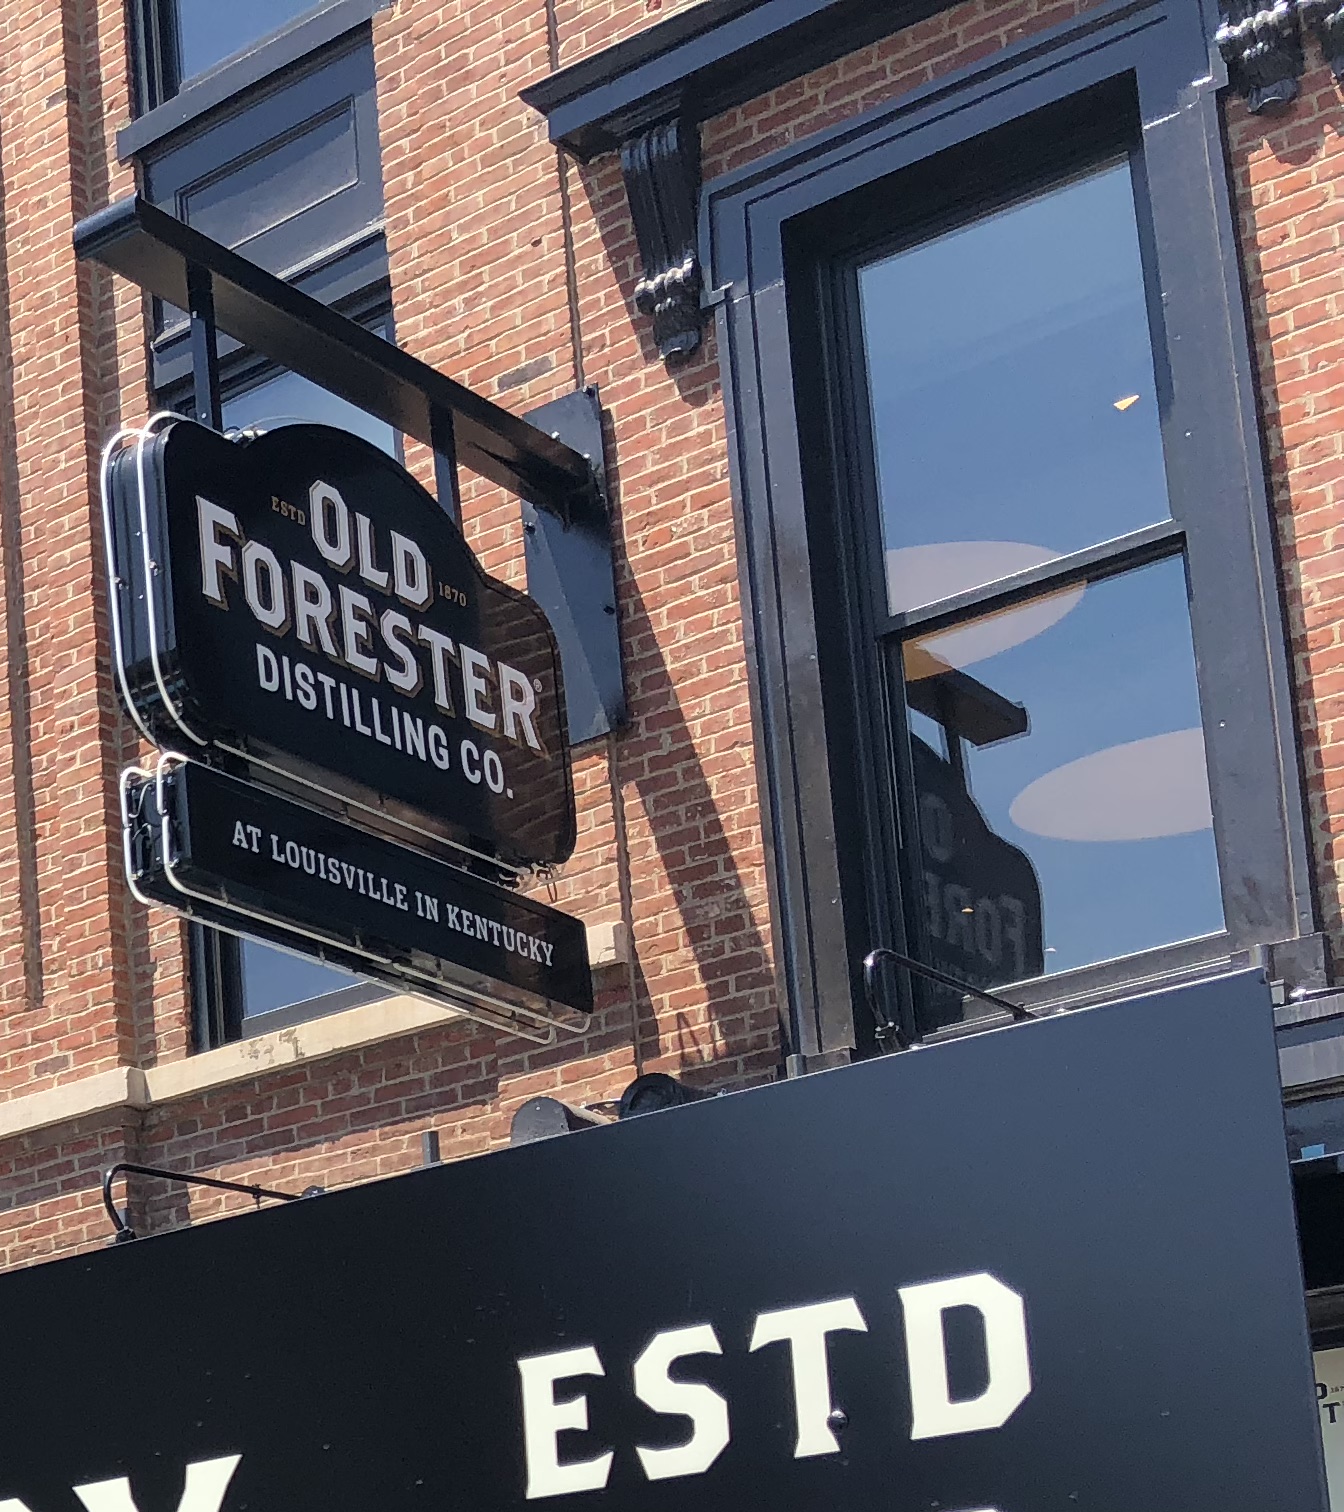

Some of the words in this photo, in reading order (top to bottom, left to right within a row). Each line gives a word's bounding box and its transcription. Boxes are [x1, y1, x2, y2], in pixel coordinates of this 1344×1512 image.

[270, 495, 306, 526] ESTD
[309, 480, 429, 607] OLD
[438, 581, 468, 608] 1870
[256, 643, 450, 770] DISTILLING
[460, 739, 514, 799] CO.
[232, 820, 262, 853] AT
[270, 834, 409, 911] LOUISVILLE
[415, 891, 439, 923] IN
[446, 903, 555, 967] KENTUCKY
[517, 1272, 1032, 1500] ESTD
